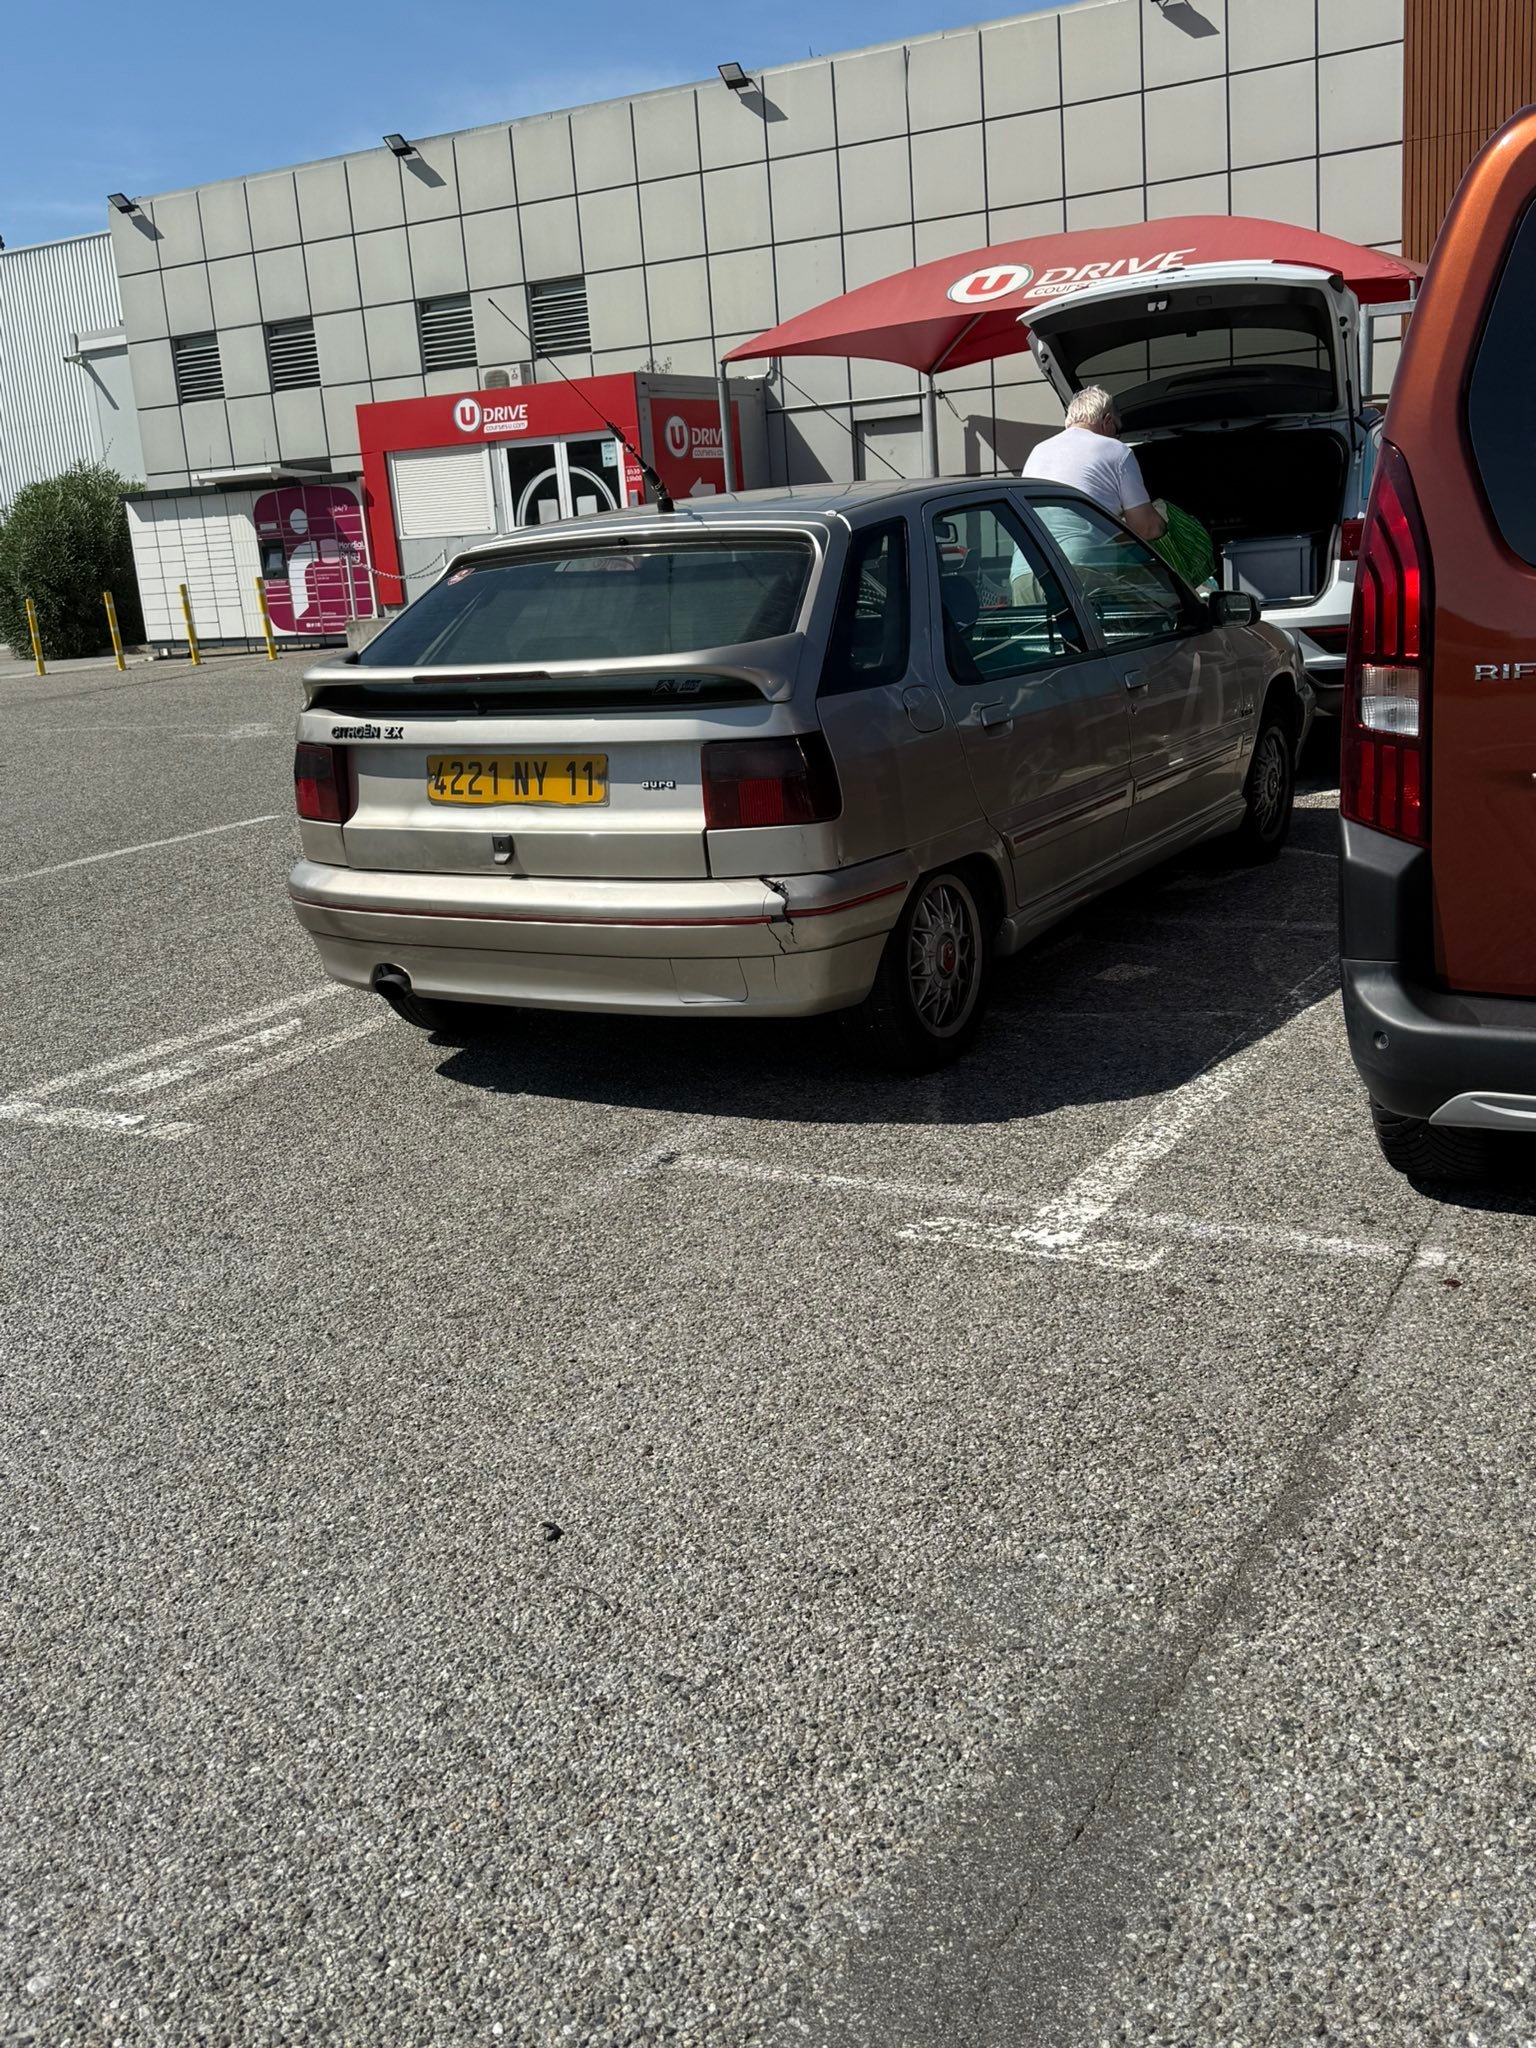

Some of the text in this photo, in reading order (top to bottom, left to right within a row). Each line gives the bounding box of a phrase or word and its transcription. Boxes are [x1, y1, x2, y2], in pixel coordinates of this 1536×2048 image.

[966, 248, 1197, 296] U DRIVE
[460, 404, 528, 426] U DRIVE
[670, 425, 723, 450] U DRIV
[331, 723, 404, 739] CITROËN ZX
[433, 761, 593, 796] 4221 NY 11
[641, 780, 676, 790] aura
